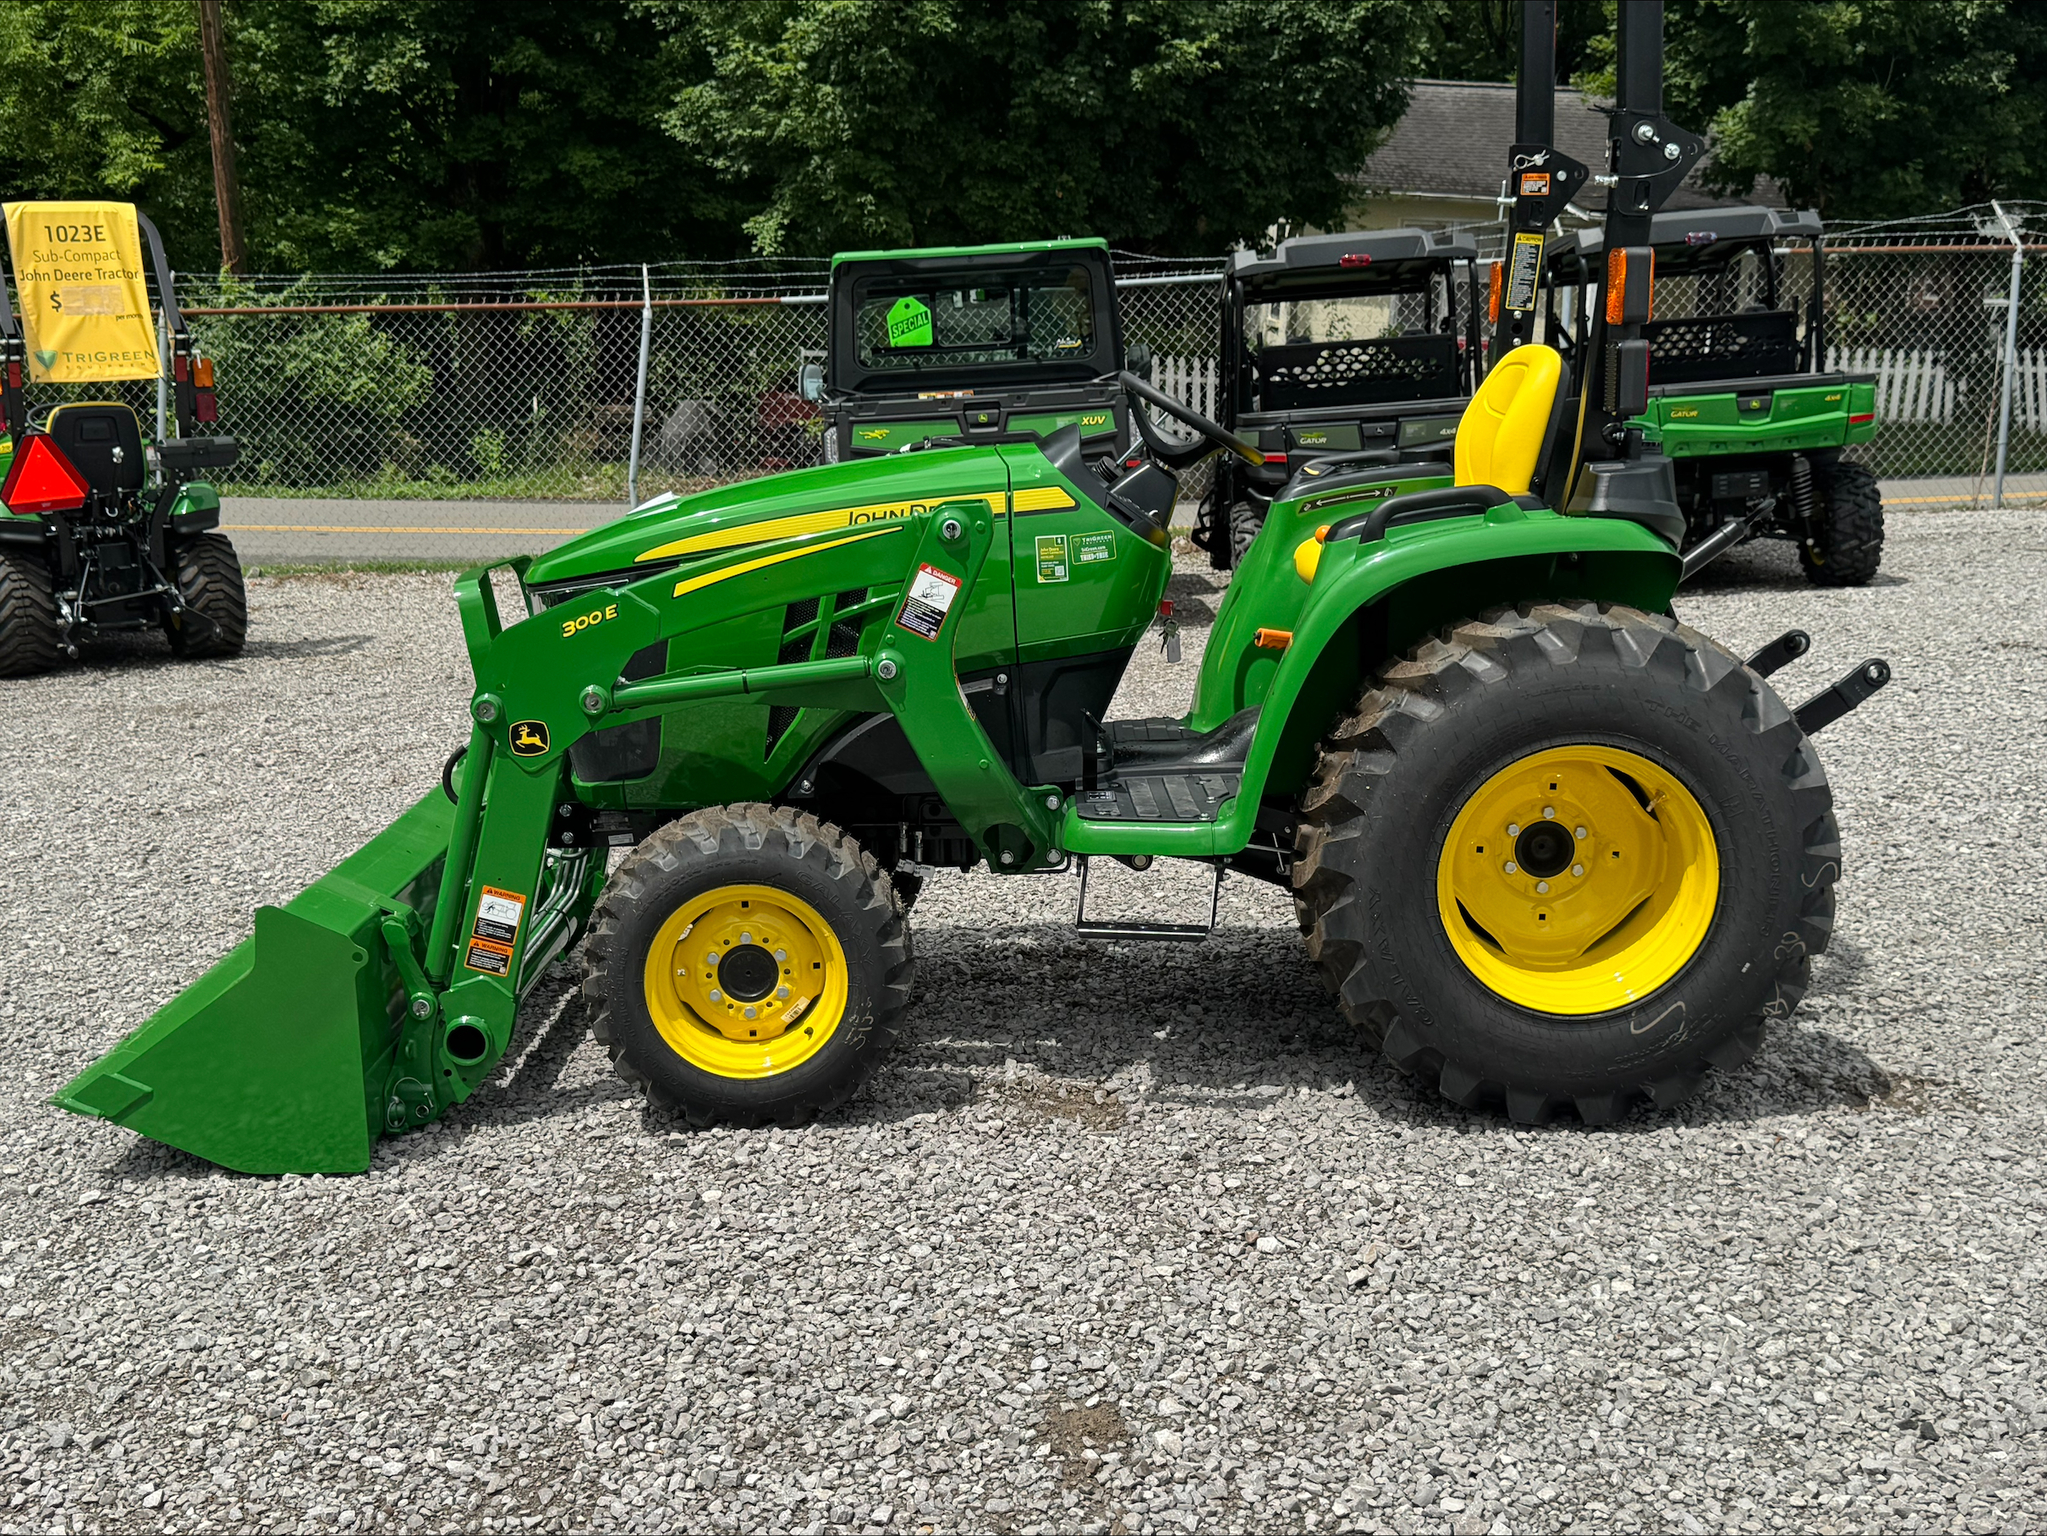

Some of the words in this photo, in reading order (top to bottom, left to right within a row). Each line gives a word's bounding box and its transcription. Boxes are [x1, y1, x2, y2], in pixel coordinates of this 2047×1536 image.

[44, 225, 107, 243] 1023E
[32, 249, 122, 264] Sub-Compact
[19, 269, 51, 282] John
[53, 268, 93, 281] Deere
[95, 268, 139, 280] Tractor
[892, 311, 929, 338] SPECIAL
[1081, 415, 1107, 426] XUV
[1670, 410, 1699, 418] GATOR
[1299, 437, 1328, 445] GATOR
[932, 570, 957, 585] DANGER
[562, 610, 603, 638] 300
[605, 603, 619, 621] E
[494, 889, 521, 901] WARNING
[481, 942, 508, 954] WARNING
